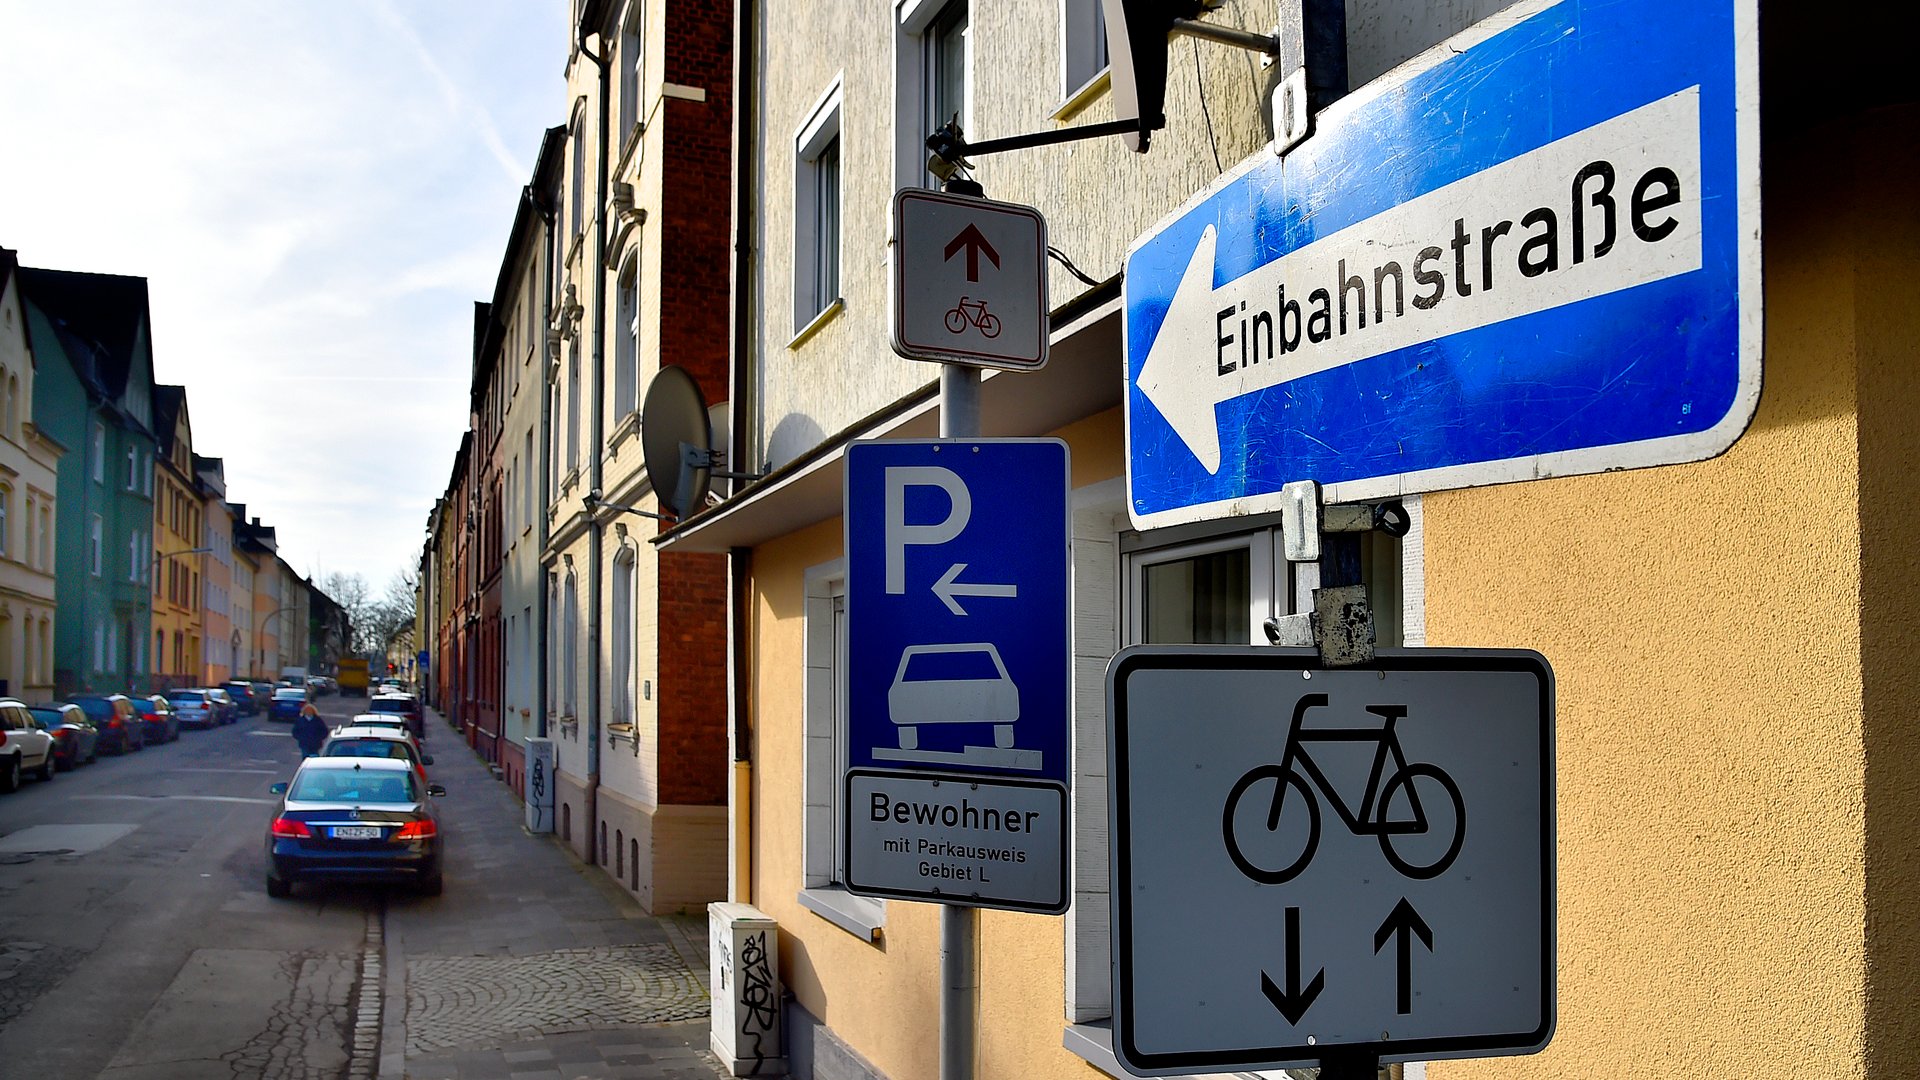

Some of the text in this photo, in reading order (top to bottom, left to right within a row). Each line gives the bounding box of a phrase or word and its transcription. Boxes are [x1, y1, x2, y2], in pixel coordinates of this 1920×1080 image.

[1216, 159, 1681, 377] Einbahnstraße
[885, 466, 971, 595] P
[870, 793, 1039, 833] Bewohner
[883, 838, 1026, 863] mit Parkausweis
[919, 861, 991, 882] Gebiet L
